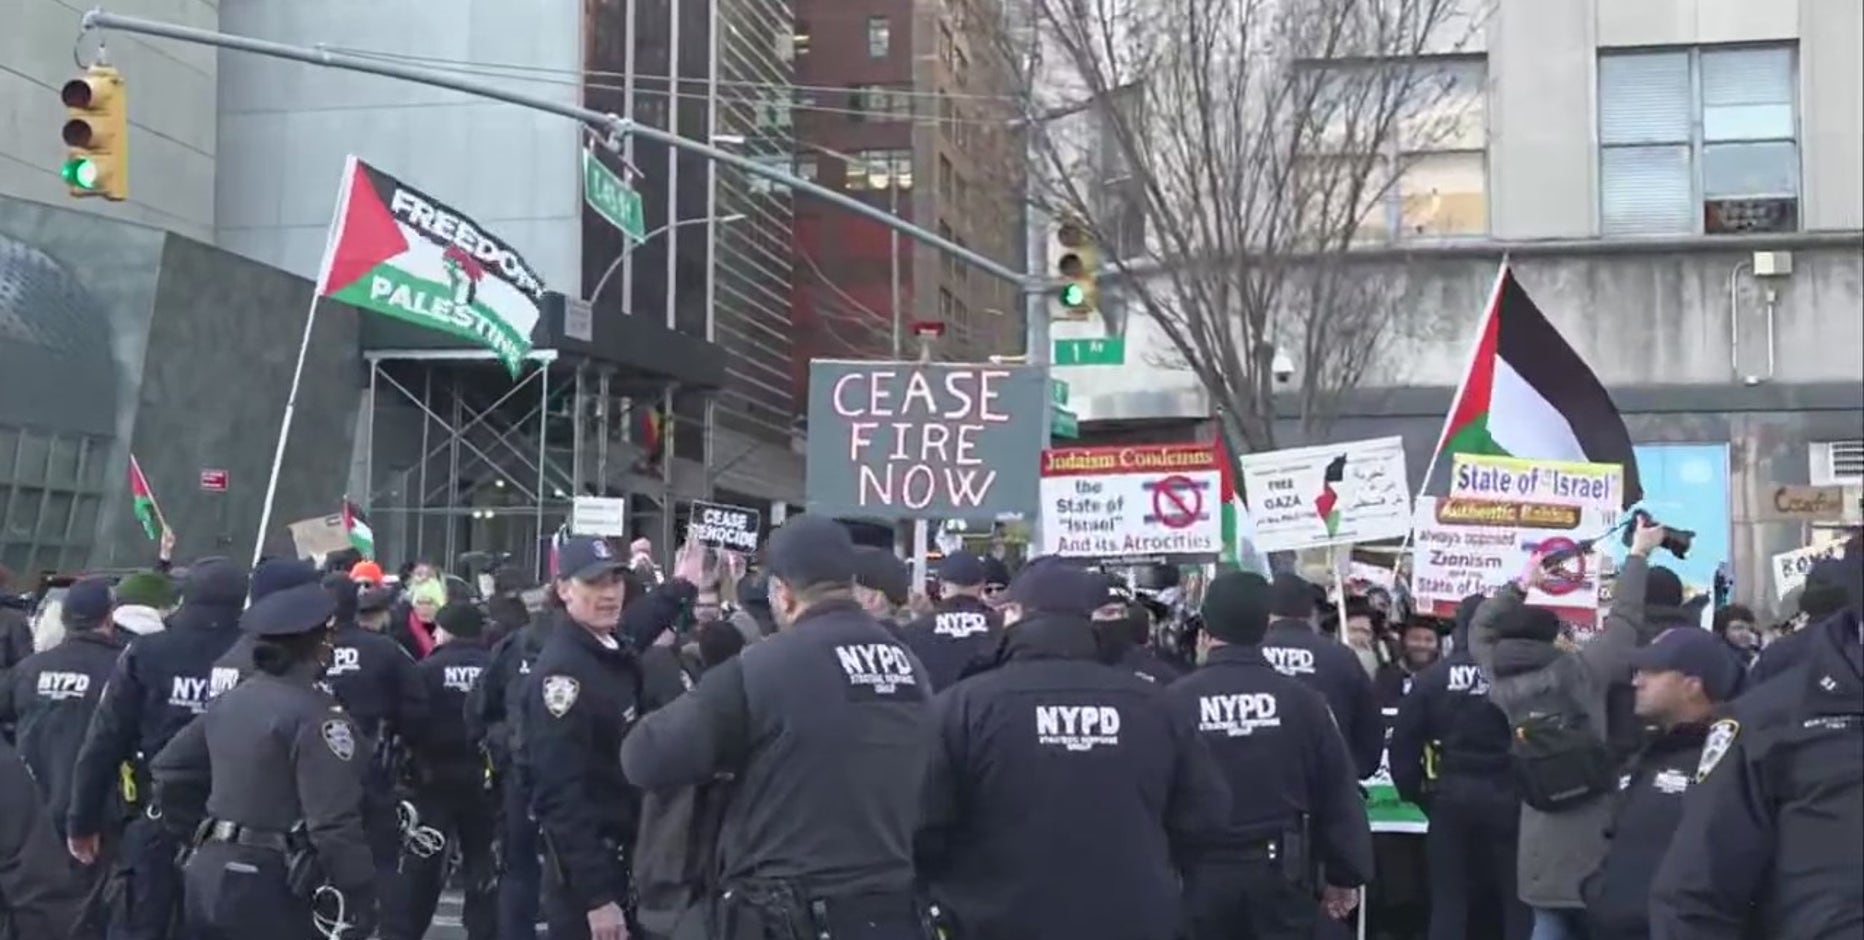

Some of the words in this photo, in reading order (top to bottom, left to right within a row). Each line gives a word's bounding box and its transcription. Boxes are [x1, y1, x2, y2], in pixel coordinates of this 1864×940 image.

[1073, 343, 1079, 362] 1
[833, 371, 1010, 421] CEASE
[850, 422, 985, 465] FIRE
[1046, 452, 1115, 471] Judaism
[1119, 447, 1215, 467] Condemns
[858, 464, 998, 509] NOW
[1075, 479, 1102, 494] the
[1458, 464, 1512, 493] State
[1518, 468, 1540, 493] of
[1056, 500, 1100, 513] State
[1107, 496, 1124, 513] of
[1264, 496, 1302, 510] GAZA
[1440, 502, 1517, 520] Authentic
[703, 509, 747, 528] CEASE
[1058, 537, 1091, 553] And
[1123, 534, 1212, 551] Atrocities
[1430, 550, 1502, 570] Zionism
[1418, 579, 1452, 593] State
[1457, 577, 1472, 594] of
[935, 612, 985, 633] NYPD
[333, 648, 360, 666] PD
[834, 644, 913, 674] NYPD
[1262, 646, 1314, 670] NYPD
[37, 671, 90, 692] NYPD
[1449, 665, 1480, 687] NY
[171, 676, 209, 701] NY
[1200, 693, 1276, 722] NYPD
[1036, 705, 1120, 735] NYPD
